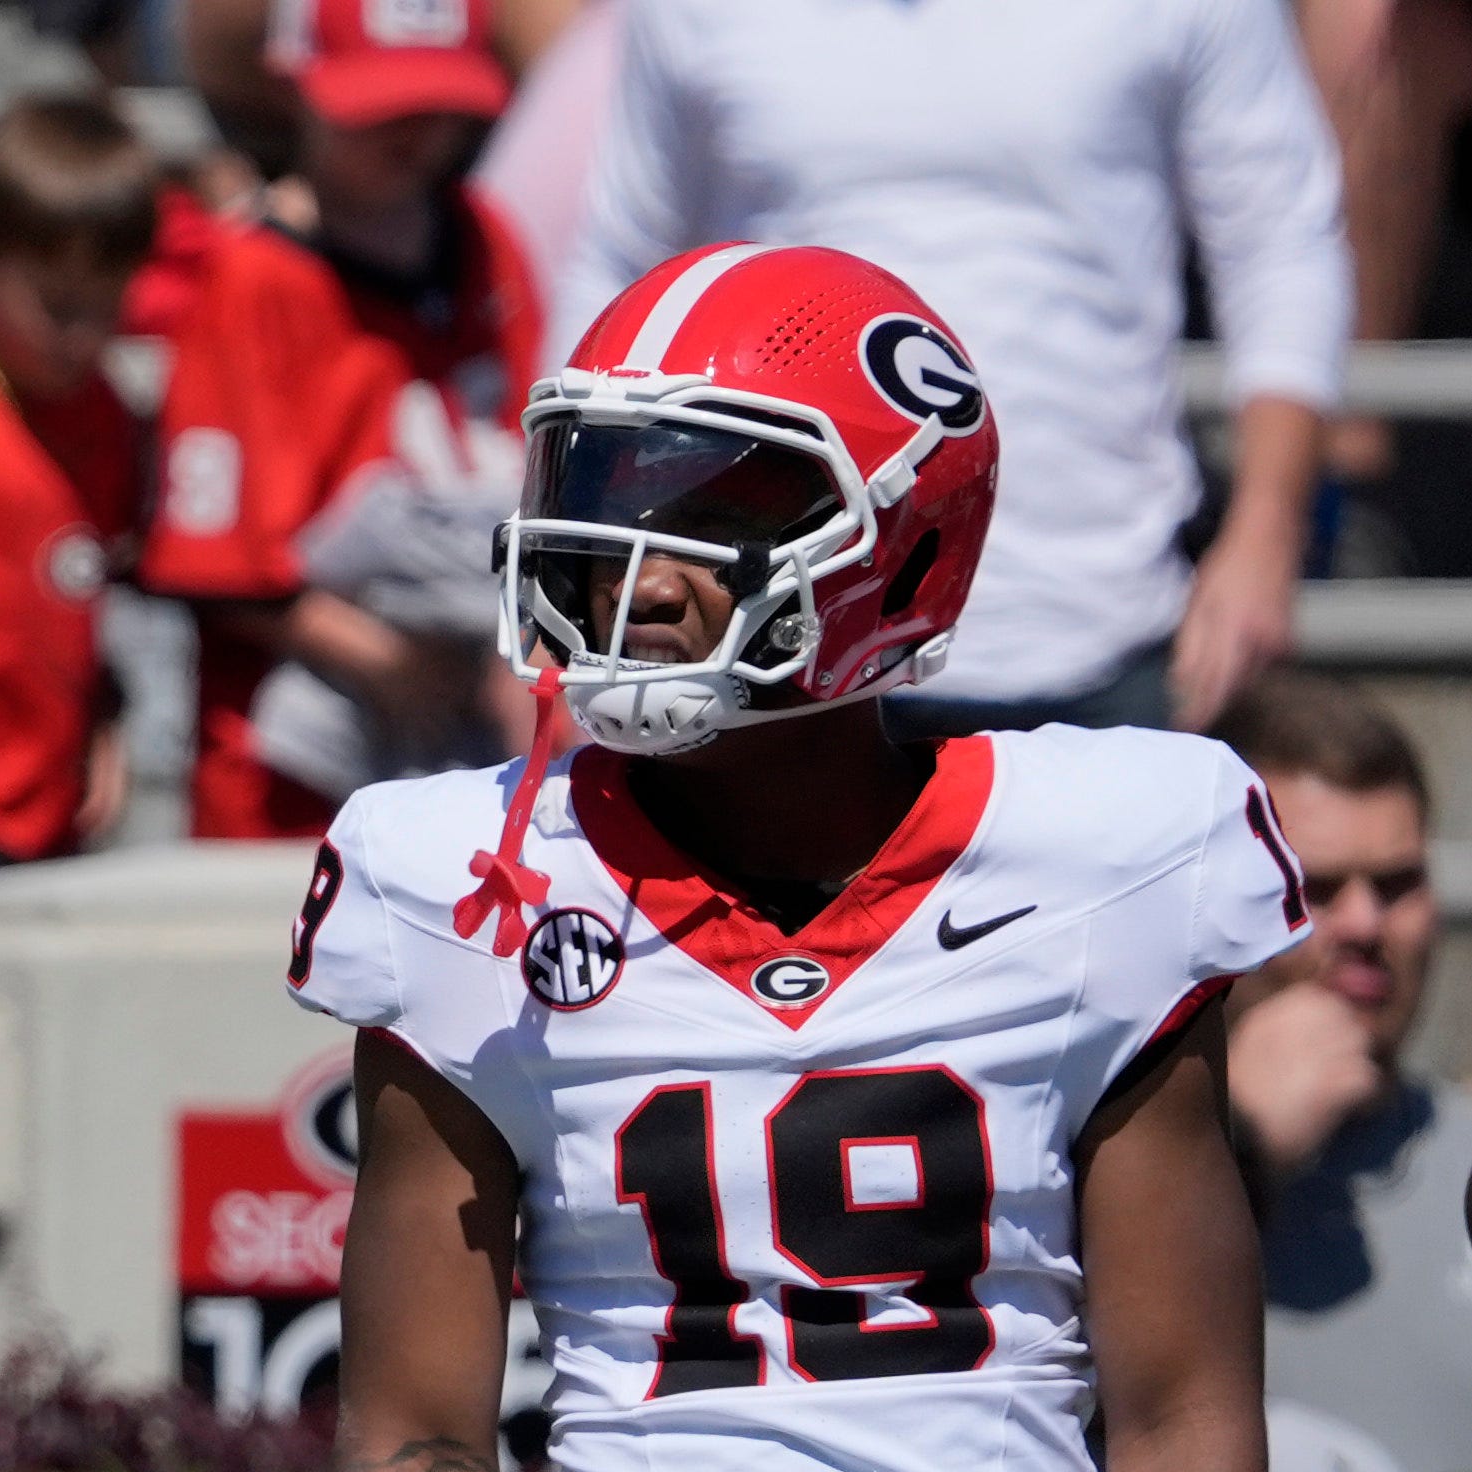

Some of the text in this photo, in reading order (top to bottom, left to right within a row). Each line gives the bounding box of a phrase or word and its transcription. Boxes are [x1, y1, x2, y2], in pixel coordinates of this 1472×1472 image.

[858, 312, 986, 437] G
[526, 911, 621, 1003] SEC
[752, 957, 828, 1006] G
[614, 1063, 996, 1401] 19
